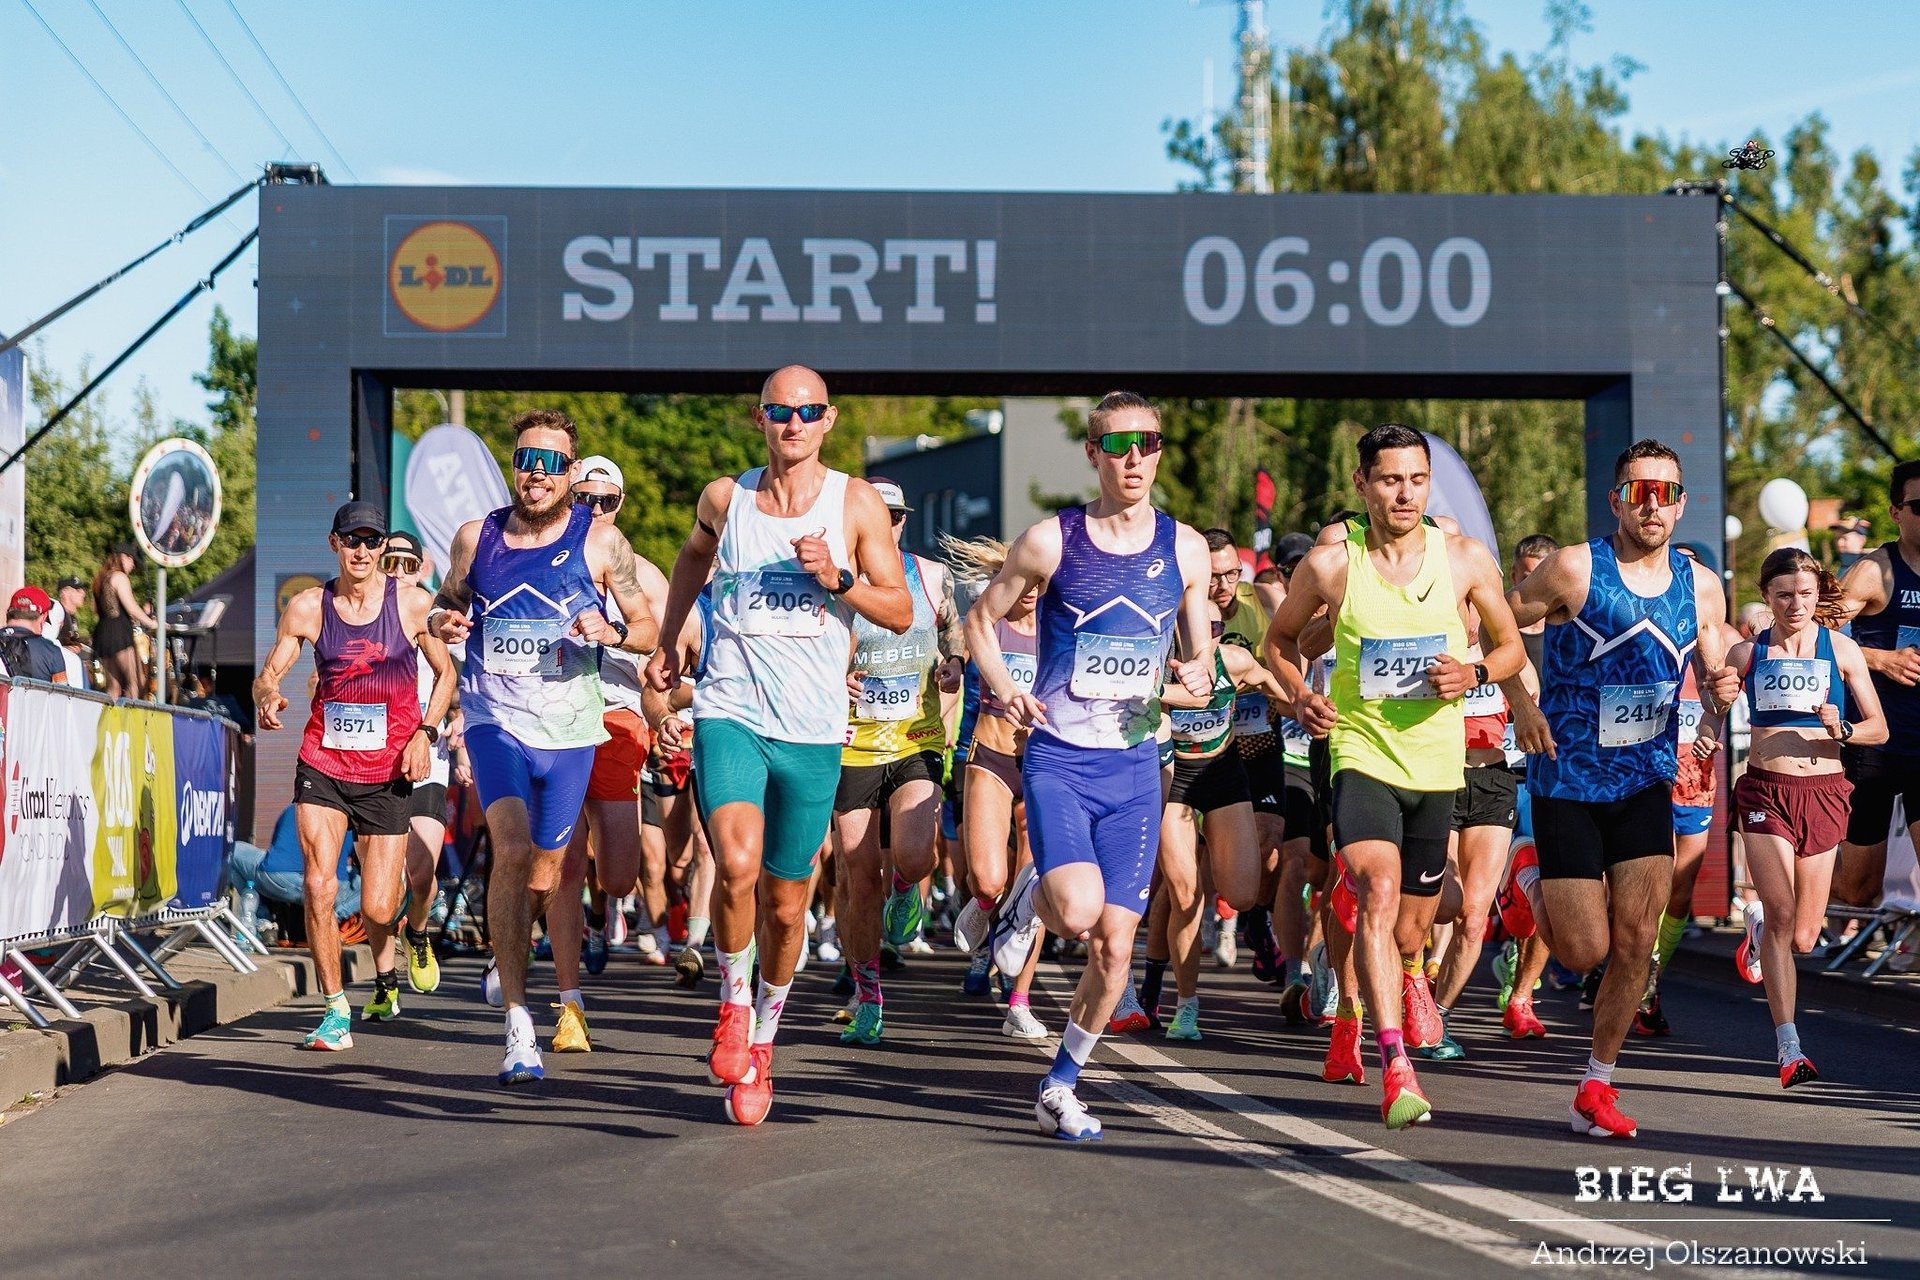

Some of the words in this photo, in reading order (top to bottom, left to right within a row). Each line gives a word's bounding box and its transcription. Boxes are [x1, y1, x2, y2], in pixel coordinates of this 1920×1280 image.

[562, 235, 998, 323] START!
[1183, 236, 1492, 327] 06:00
[748, 590, 814, 612] 2006
[493, 636, 550, 655] 2008
[854, 644, 925, 665] MEBEL
[1086, 655, 1150, 676] 2002
[1373, 656, 1437, 677] 2475
[1763, 674, 1820, 692] 2009
[865, 689, 910, 705] 3489
[1614, 700, 1665, 724] 2414
[333, 717, 375, 733] 3571
[1181, 716, 1226, 734] 2005
